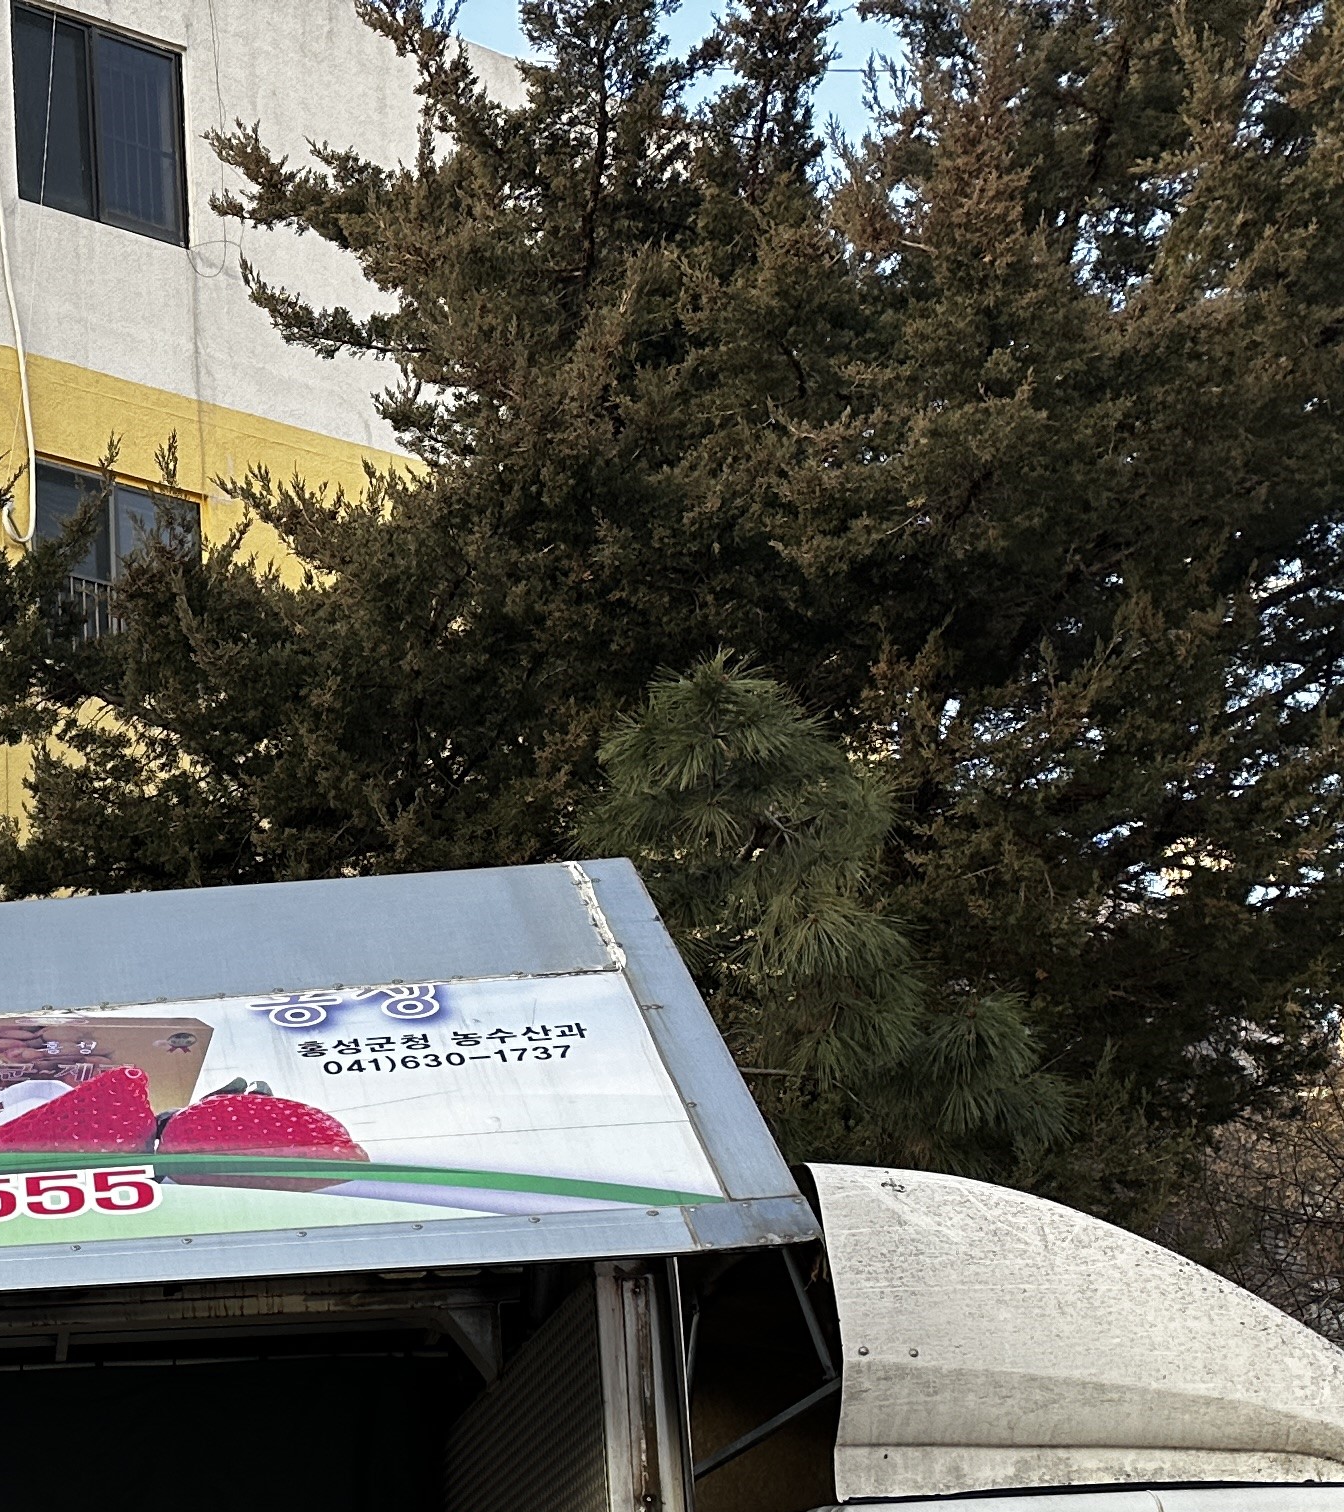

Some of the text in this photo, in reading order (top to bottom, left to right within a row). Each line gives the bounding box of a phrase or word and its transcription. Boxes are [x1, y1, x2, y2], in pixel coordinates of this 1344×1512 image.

[297, 1022, 588, 1058] 홍성군청 농수산과
[323, 1045, 572, 1075] 041)630-1737
